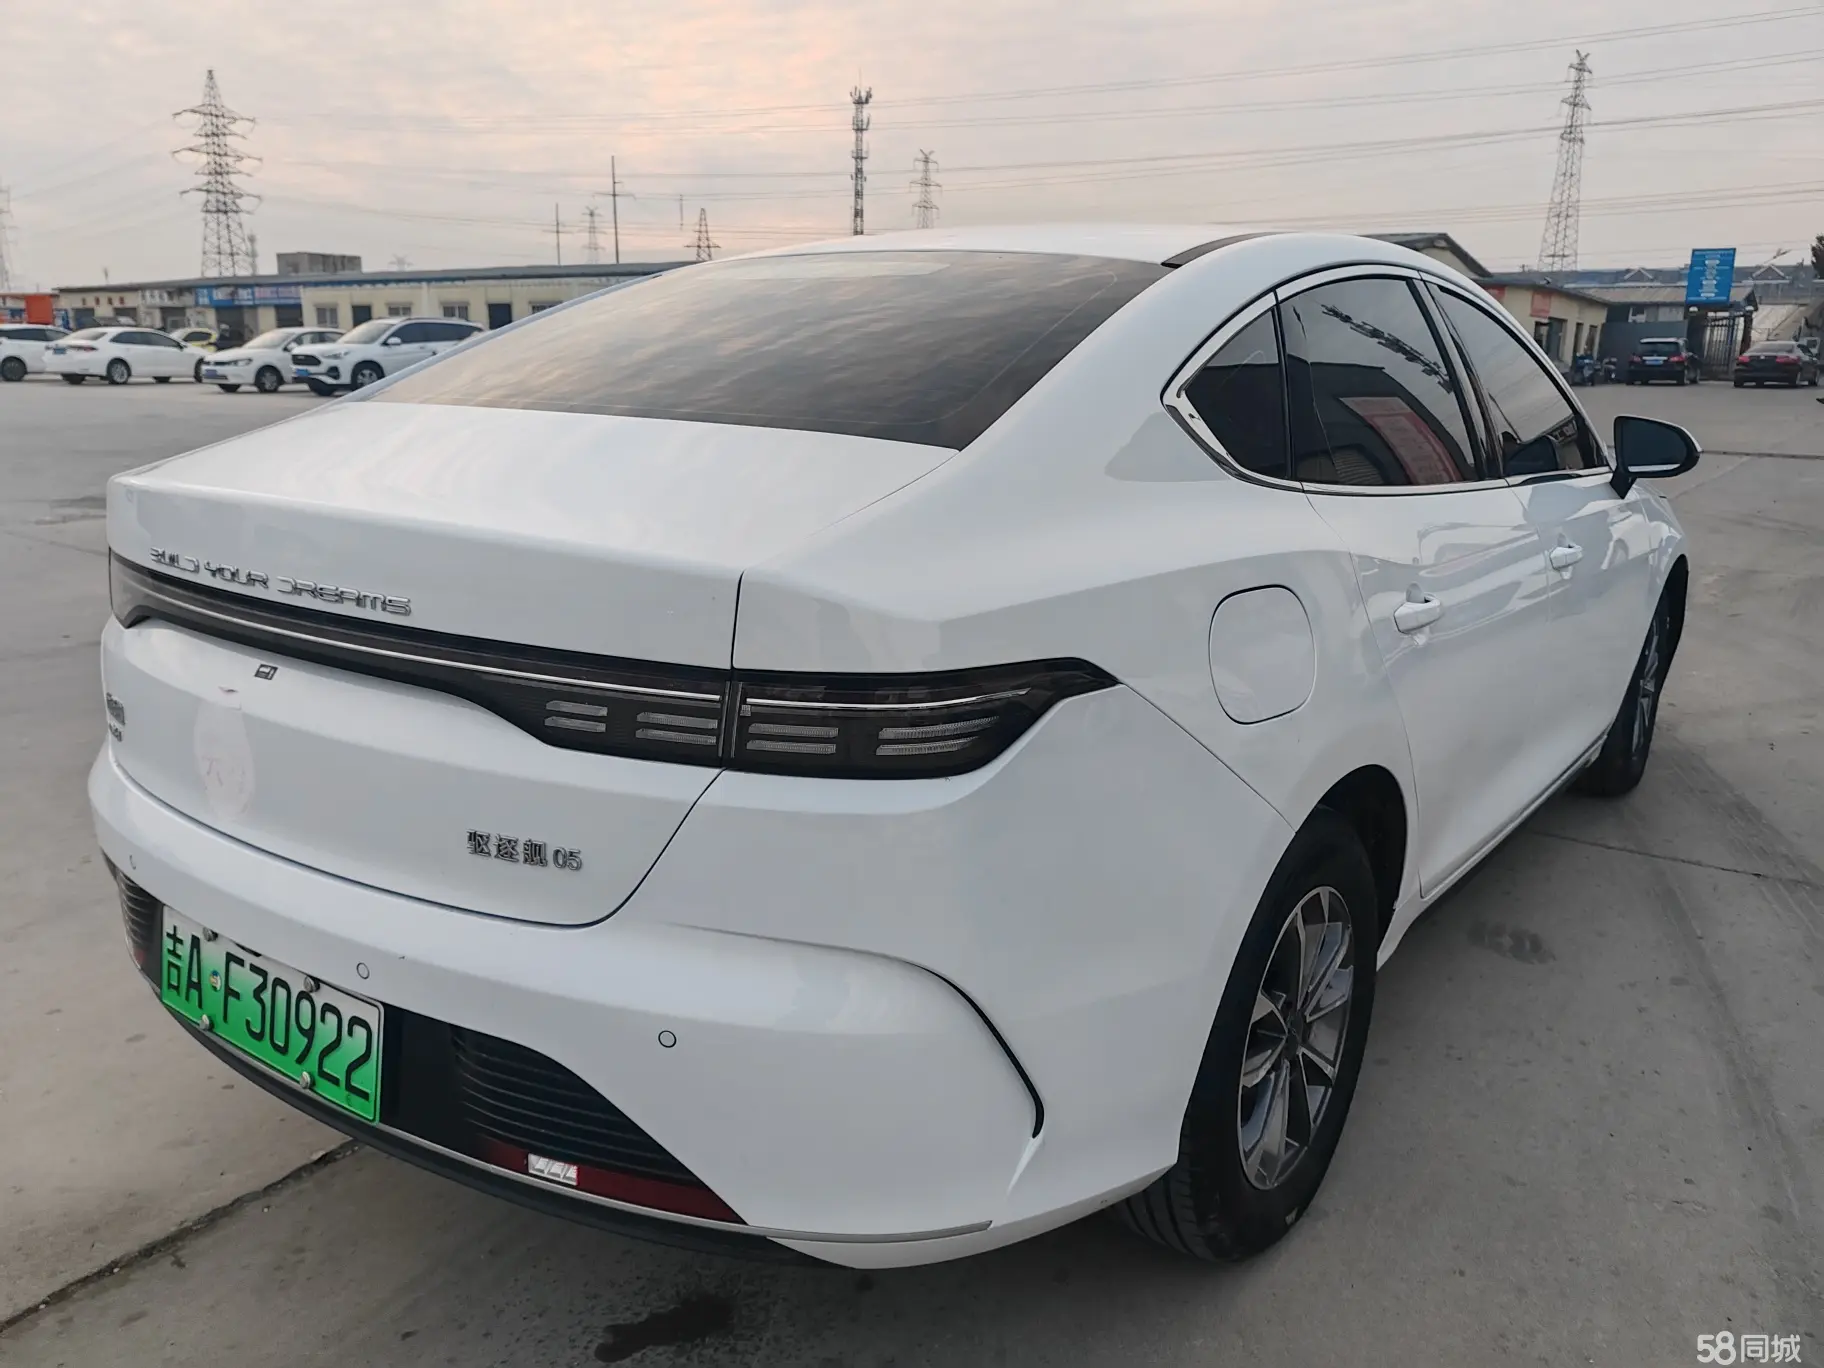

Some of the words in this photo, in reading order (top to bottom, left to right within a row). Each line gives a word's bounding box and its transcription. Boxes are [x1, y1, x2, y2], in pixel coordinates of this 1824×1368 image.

[150, 546, 200, 574] BUILD
[204, 560, 269, 589] YOUR
[276, 575, 412, 617] DREAMS
[466, 828, 548, 868] 驱逐舰
[552, 846, 583, 871] 05
